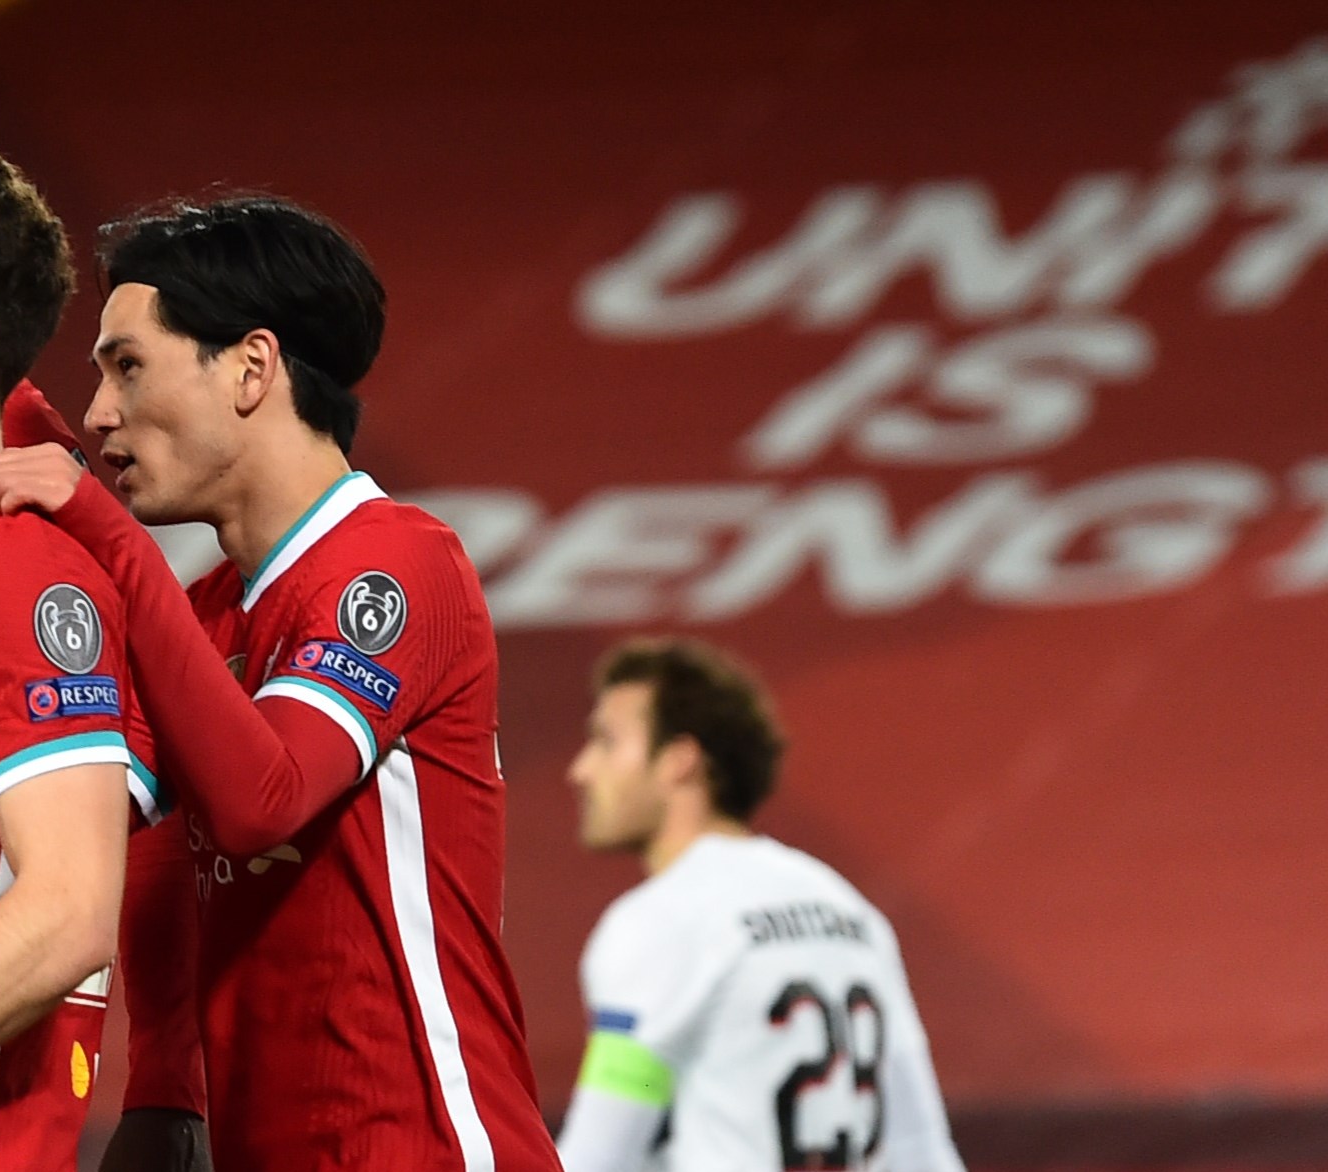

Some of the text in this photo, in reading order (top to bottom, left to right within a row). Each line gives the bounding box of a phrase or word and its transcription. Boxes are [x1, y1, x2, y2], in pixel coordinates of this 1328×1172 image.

[748, 315, 1151, 467] IS
[362, 608, 379, 632] 6
[66, 626, 82, 650] 6
[322, 650, 398, 701] RESPECT
[60, 685, 119, 705] RESPEC
